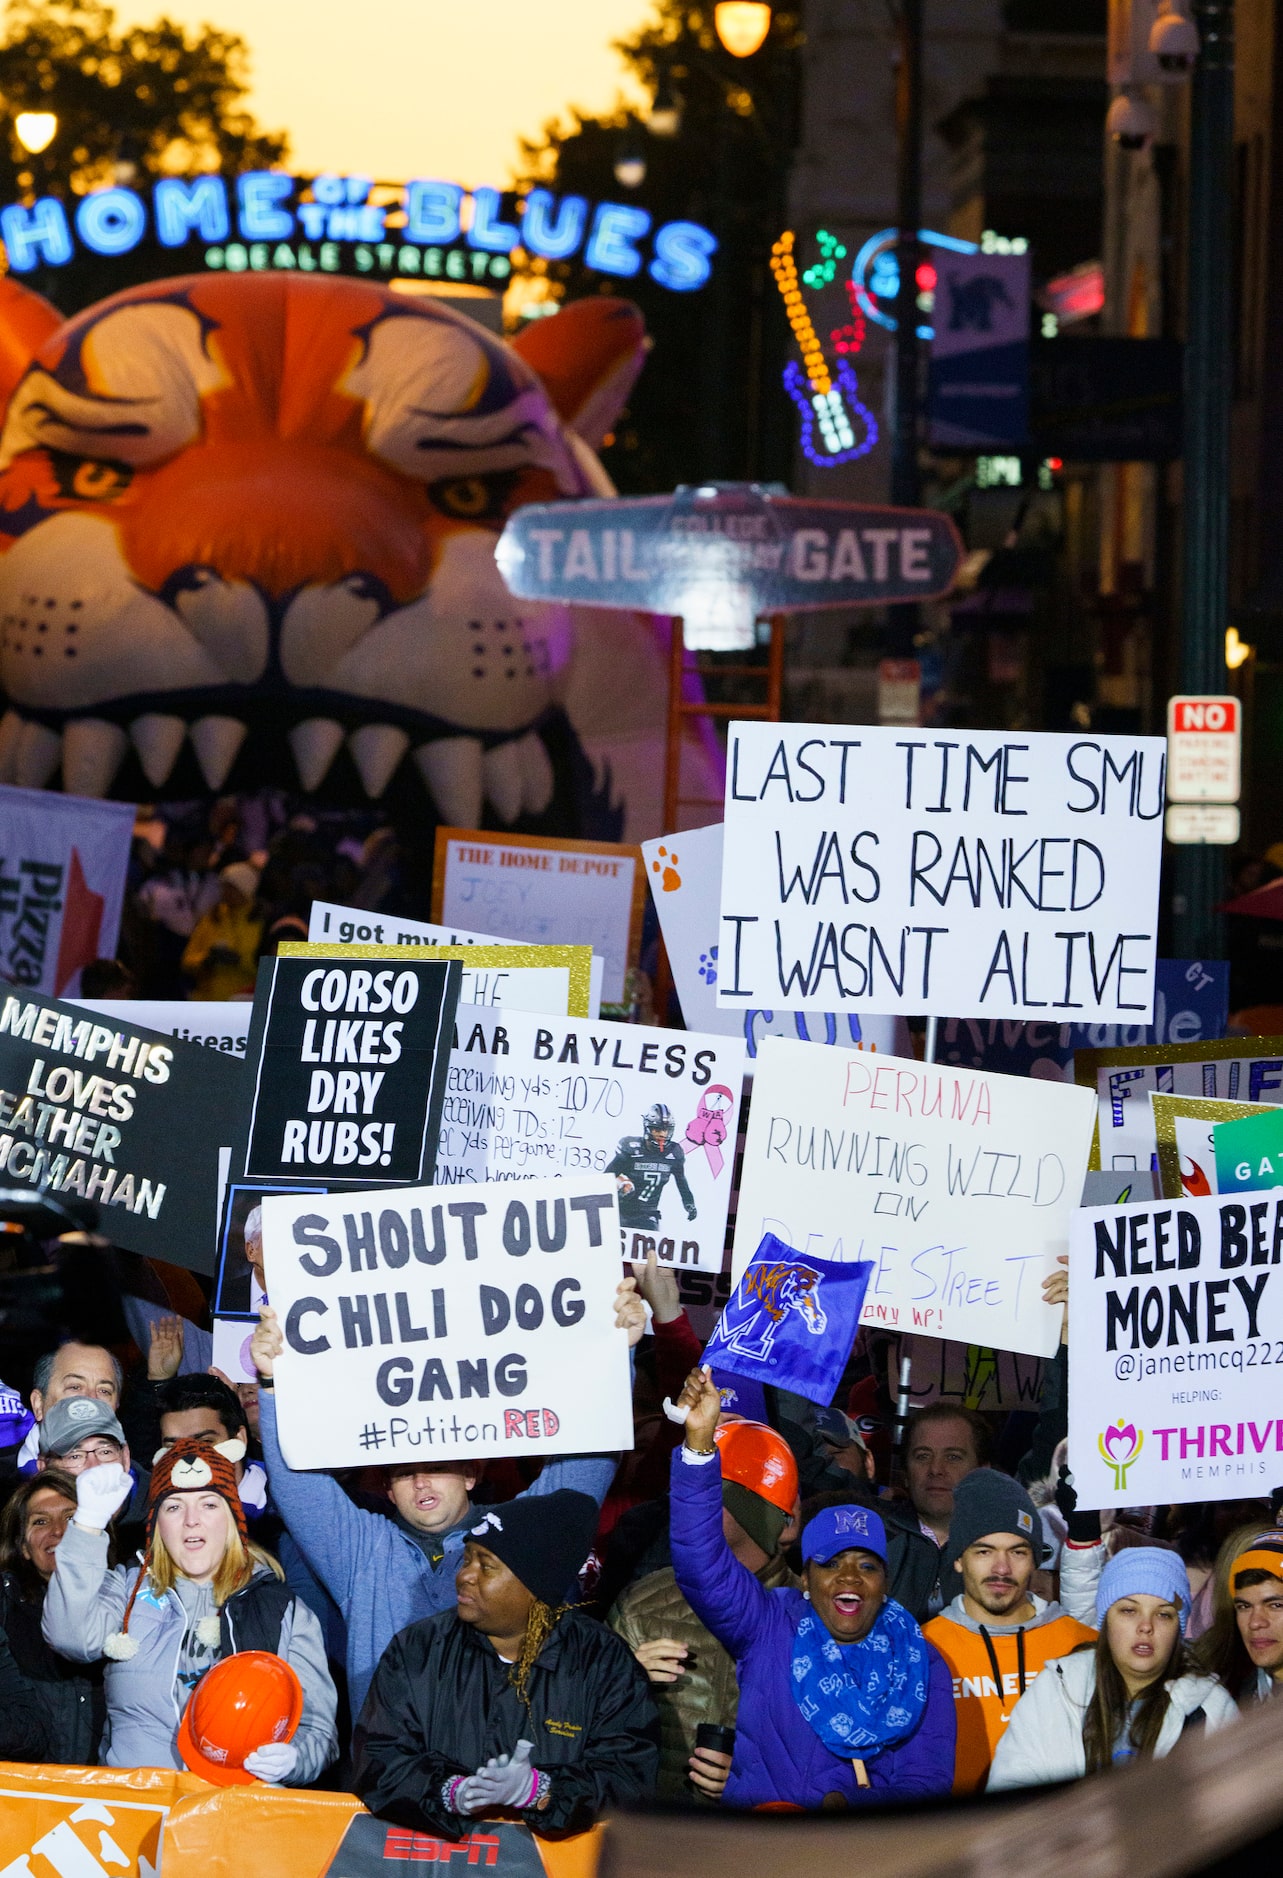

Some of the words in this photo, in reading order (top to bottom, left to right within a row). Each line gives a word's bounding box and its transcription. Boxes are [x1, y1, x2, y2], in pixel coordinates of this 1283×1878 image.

[312, 175, 374, 204] OF
[2, 171, 295, 272] HOME
[300, 202, 386, 242] THE
[404, 178, 718, 291] BLUES
[225, 242, 340, 272] BEALE
[355, 243, 491, 279] STREET
[529, 530, 650, 581] TAIL
[792, 527, 933, 582] GATE
[1182, 704, 1226, 730] NO
[731, 737, 861, 803] LAST
[896, 742, 1029, 815] TIME
[1067, 742, 1165, 820] SMU
[458, 847, 494, 865] THE
[501, 850, 553, 872] HOME
[559, 857, 622, 877] DEPOT
[776, 831, 881, 905] WAS
[910, 830, 1106, 911] RANKED
[339, 921, 385, 944] got
[720, 915, 760, 996] I
[774, 922, 949, 999] WASN'T
[979, 930, 1152, 1010] ALIVE
[300, 969, 419, 1014] CORSO
[0, 997, 174, 1085] MEMPHIS
[300, 1019, 404, 1064] LIKES
[452, 1023, 510, 1055] AR
[533, 1028, 716, 1085] BAYLESS
[27, 1059, 136, 1122] LOVES
[307, 1070, 385, 1114] DRY
[843, 1061, 992, 1126] PERUNA
[280, 1120, 396, 1166] RUBS!
[766, 1116, 929, 1187] RUNNING
[948, 1143, 1066, 1207] WILD
[1234, 1152, 1283, 1181] GA
[874, 1191, 929, 1222] ON
[292, 1201, 488, 1277] SHOUT
[502, 1193, 614, 1257] OUT
[1094, 1209, 1201, 1279] NEED
[285, 1288, 448, 1355] CHILI
[480, 1277, 586, 1337] DOG
[1106, 1272, 1270, 1352] MONEY
[376, 1353, 528, 1407] GANG
[1171, 1390, 1222, 1404] HELPING:
[1181, 1461, 1267, 1480] MEMPHIS
[834, 1509, 869, 1537] M
[383, 1828, 500, 1866] ESPN
